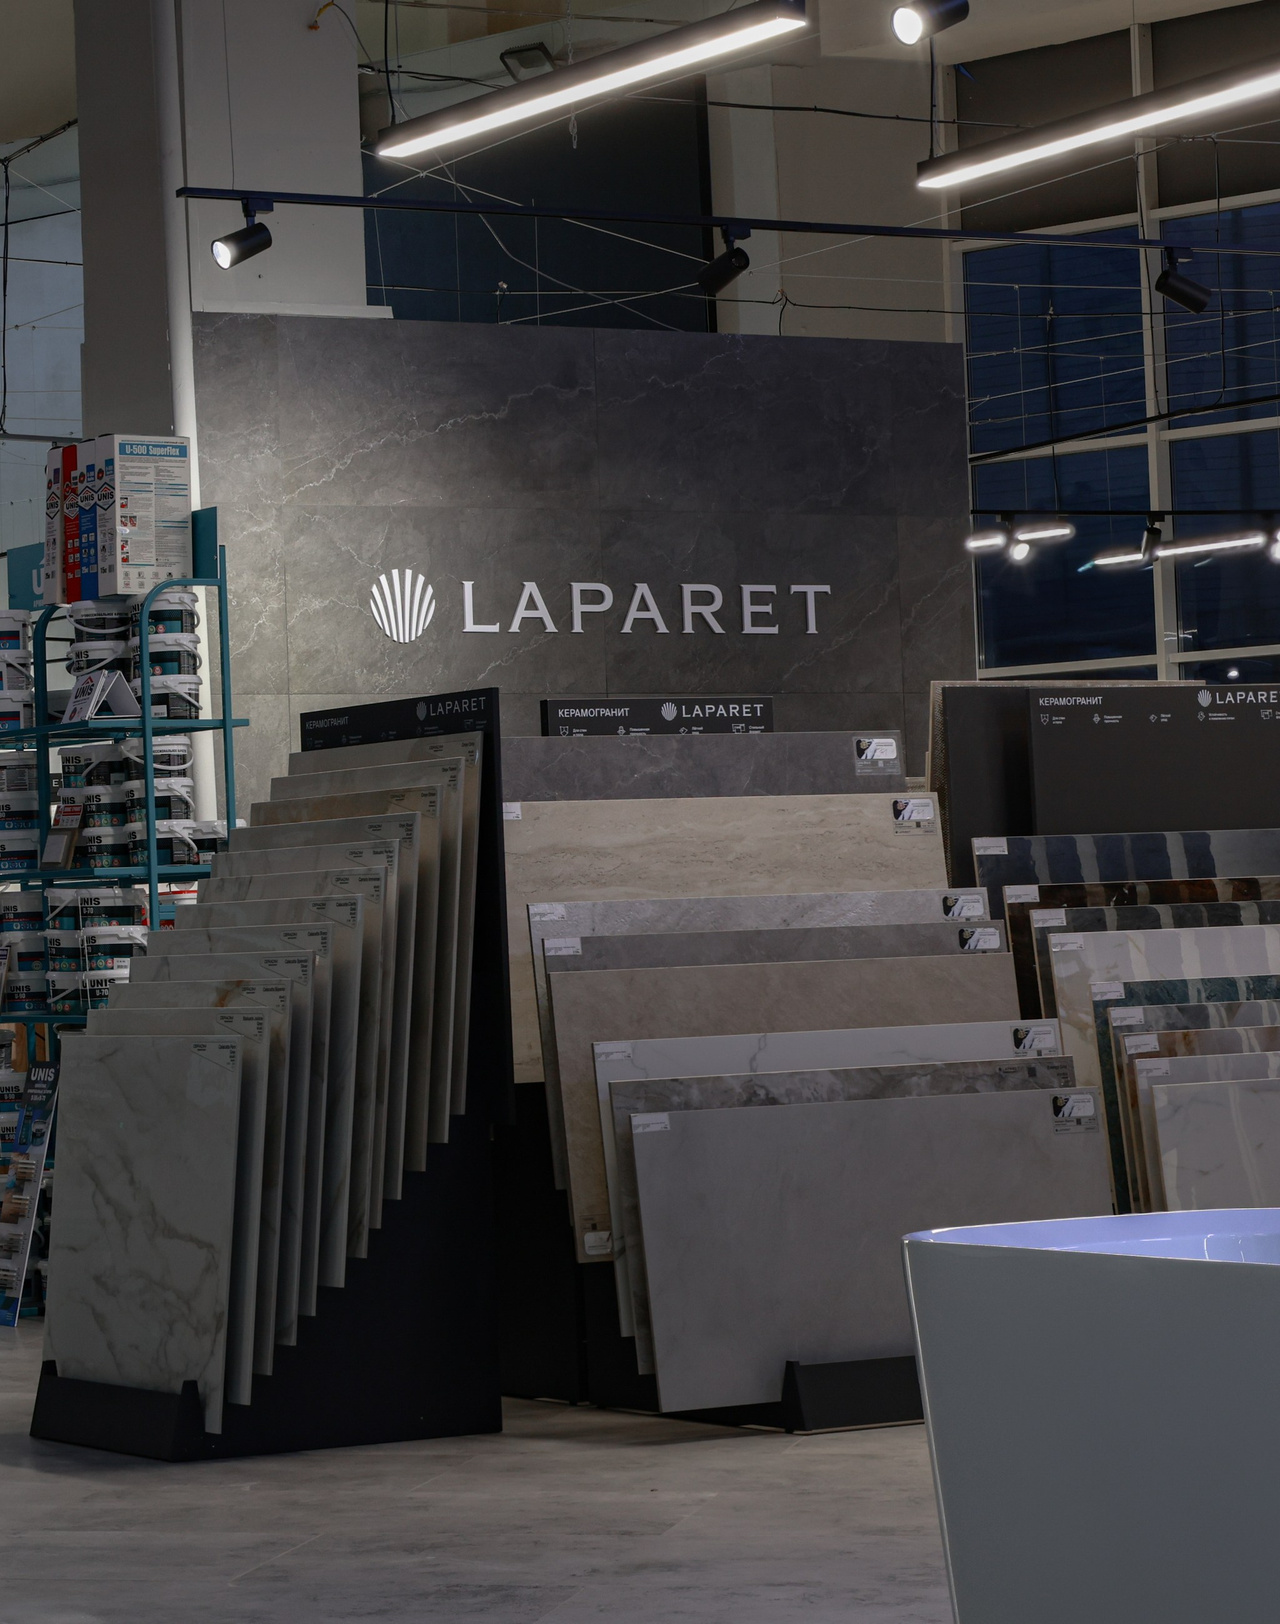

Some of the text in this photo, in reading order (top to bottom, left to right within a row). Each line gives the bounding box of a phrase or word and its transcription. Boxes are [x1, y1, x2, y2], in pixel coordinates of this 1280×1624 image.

[125, 445, 180, 456] U-500 SuperFlex
[80, 494, 95, 503] UNIS
[97, 491, 114, 501] UNIS
[46, 501, 59, 510] UNIS
[66, 501, 79, 510] UNIS
[461, 581, 831, 635] LAPARET
[75, 651, 89, 659] NIS
[74, 684, 95, 699] UNIS
[1039, 697, 1103, 706] КЕРАМОГРАНИТ
[1216, 691, 1279, 704] LAPARE
[430, 697, 486, 717] LAPARET
[682, 704, 764, 718] LAPARET
[558, 708, 630, 718] КЕРАМОГРАНИТ
[305, 716, 349, 730] КЕРАМОГРАНИТ
[62, 797, 76, 805] NIS
[30, 1067, 55, 1082] UNIS
